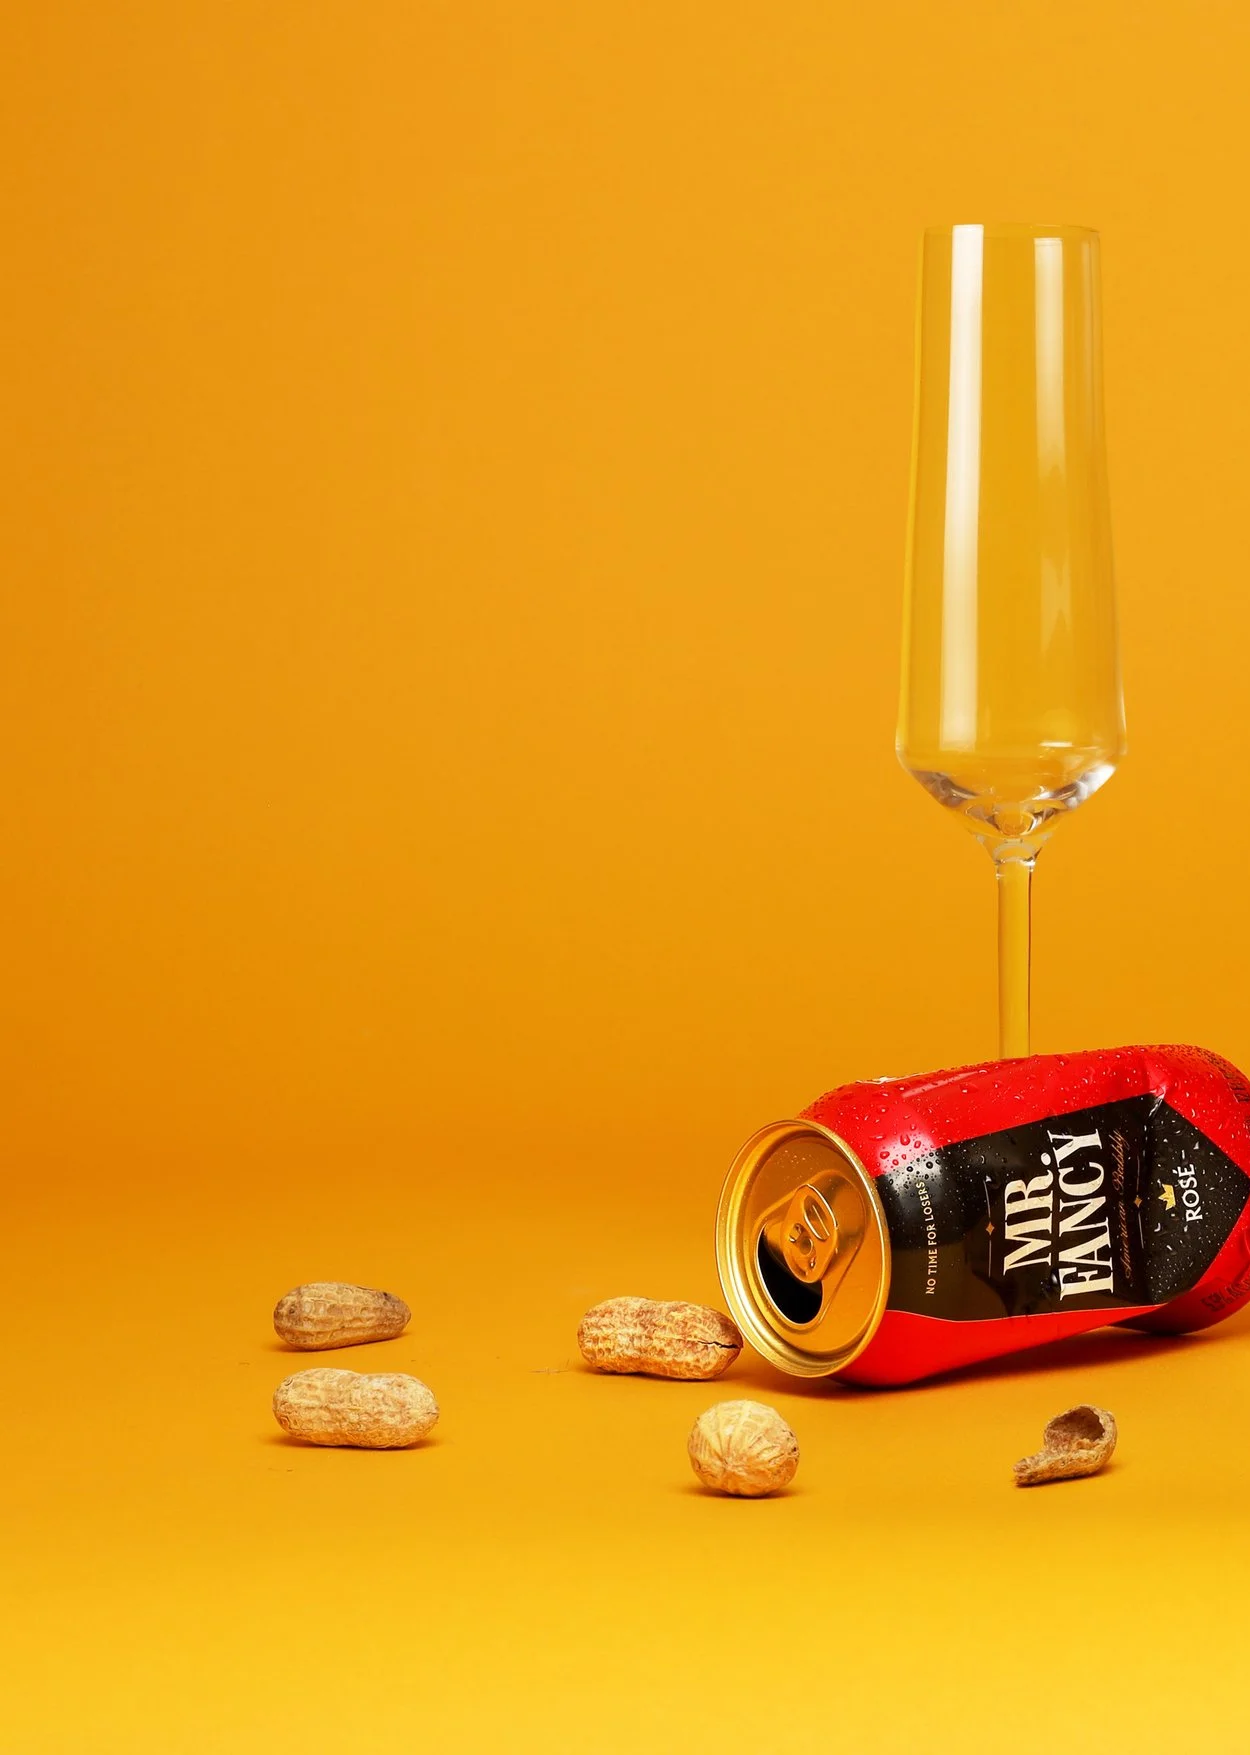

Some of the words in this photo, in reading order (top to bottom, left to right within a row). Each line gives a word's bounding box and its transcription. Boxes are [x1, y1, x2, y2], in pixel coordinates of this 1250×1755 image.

[915, 1181, 934, 1222] LOSERS
[1172, 1163, 1203, 1222] ROSÉ
[926, 1223, 937, 1246] FOR
[1003, 1152, 1054, 1276] MR.
[1047, 1129, 1114, 1301] FANCY
[928, 1248, 938, 1275] TIME
[925, 1278, 936, 1294] NO
